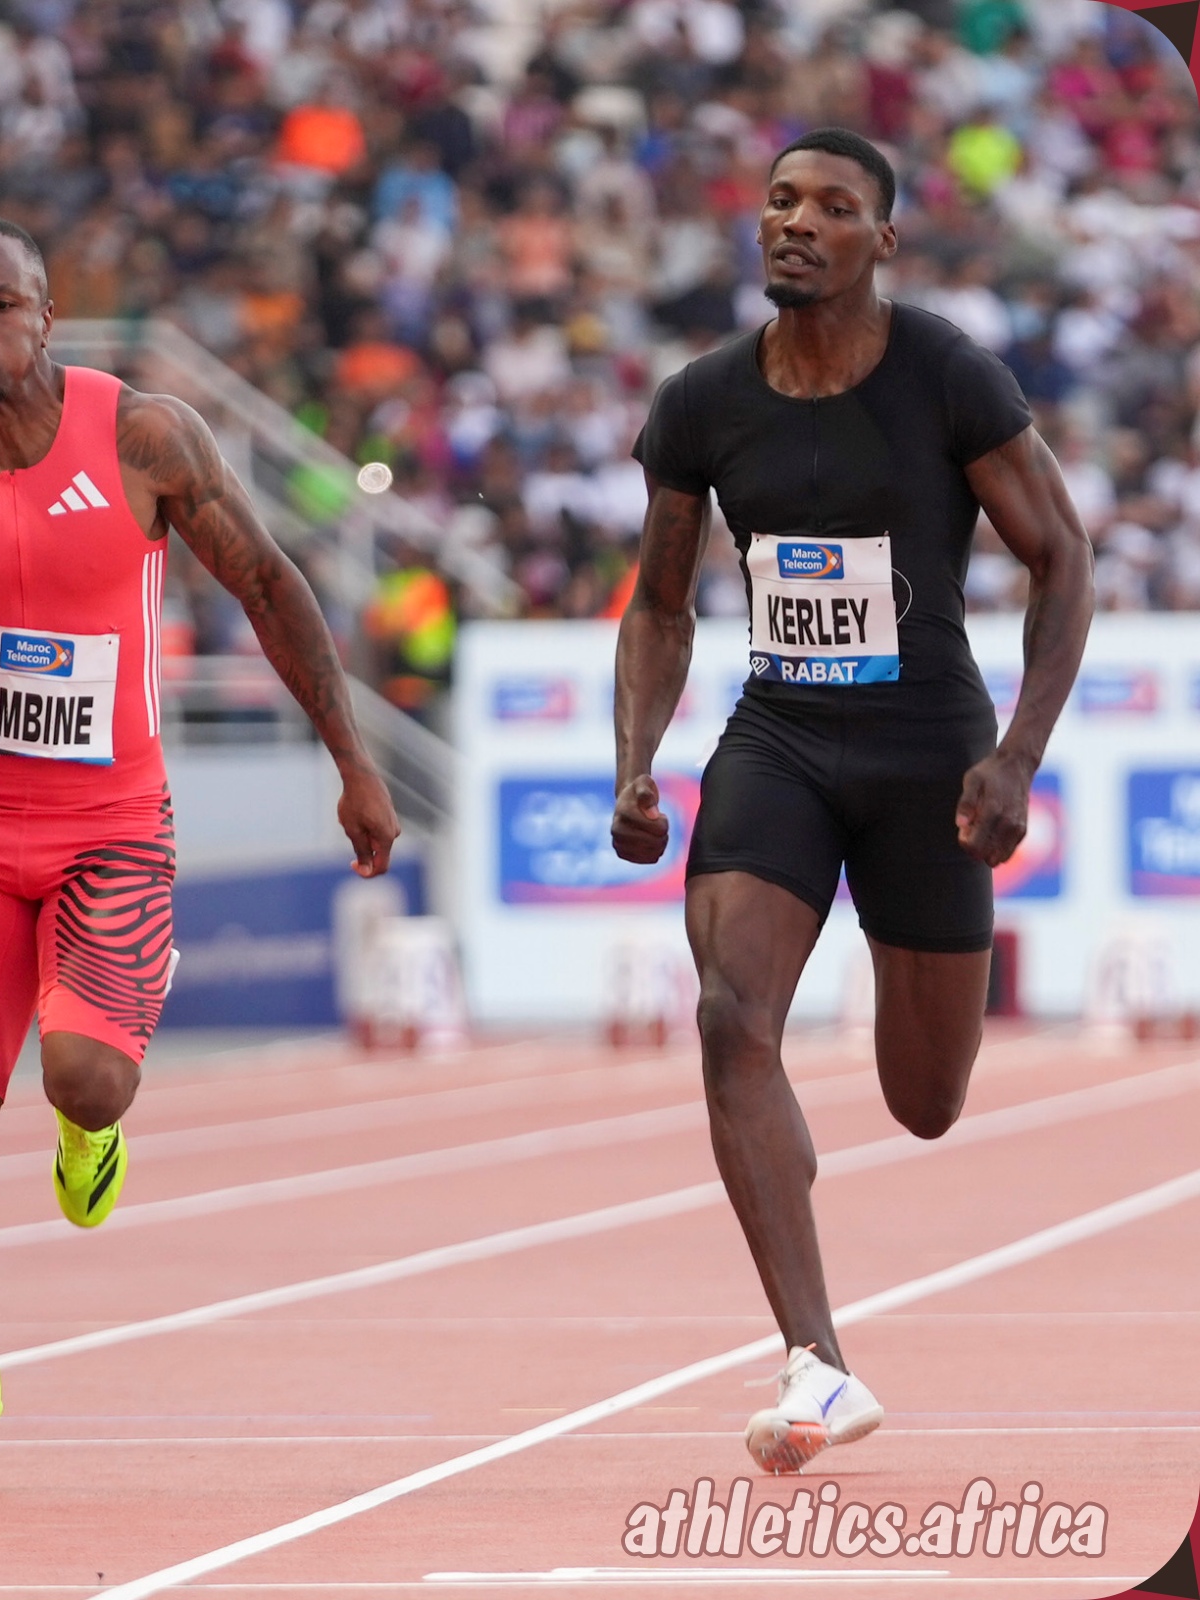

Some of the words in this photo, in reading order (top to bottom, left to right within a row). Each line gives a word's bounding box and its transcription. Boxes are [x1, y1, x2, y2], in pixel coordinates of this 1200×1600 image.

[792, 548, 822, 560] Maroc
[783, 558, 823, 570] Telecom
[767, 594, 869, 645] KERLEY
[16, 640, 51, 654] Maroc
[7, 649, 50, 665] Telecom
[781, 661, 858, 682] RABAT
